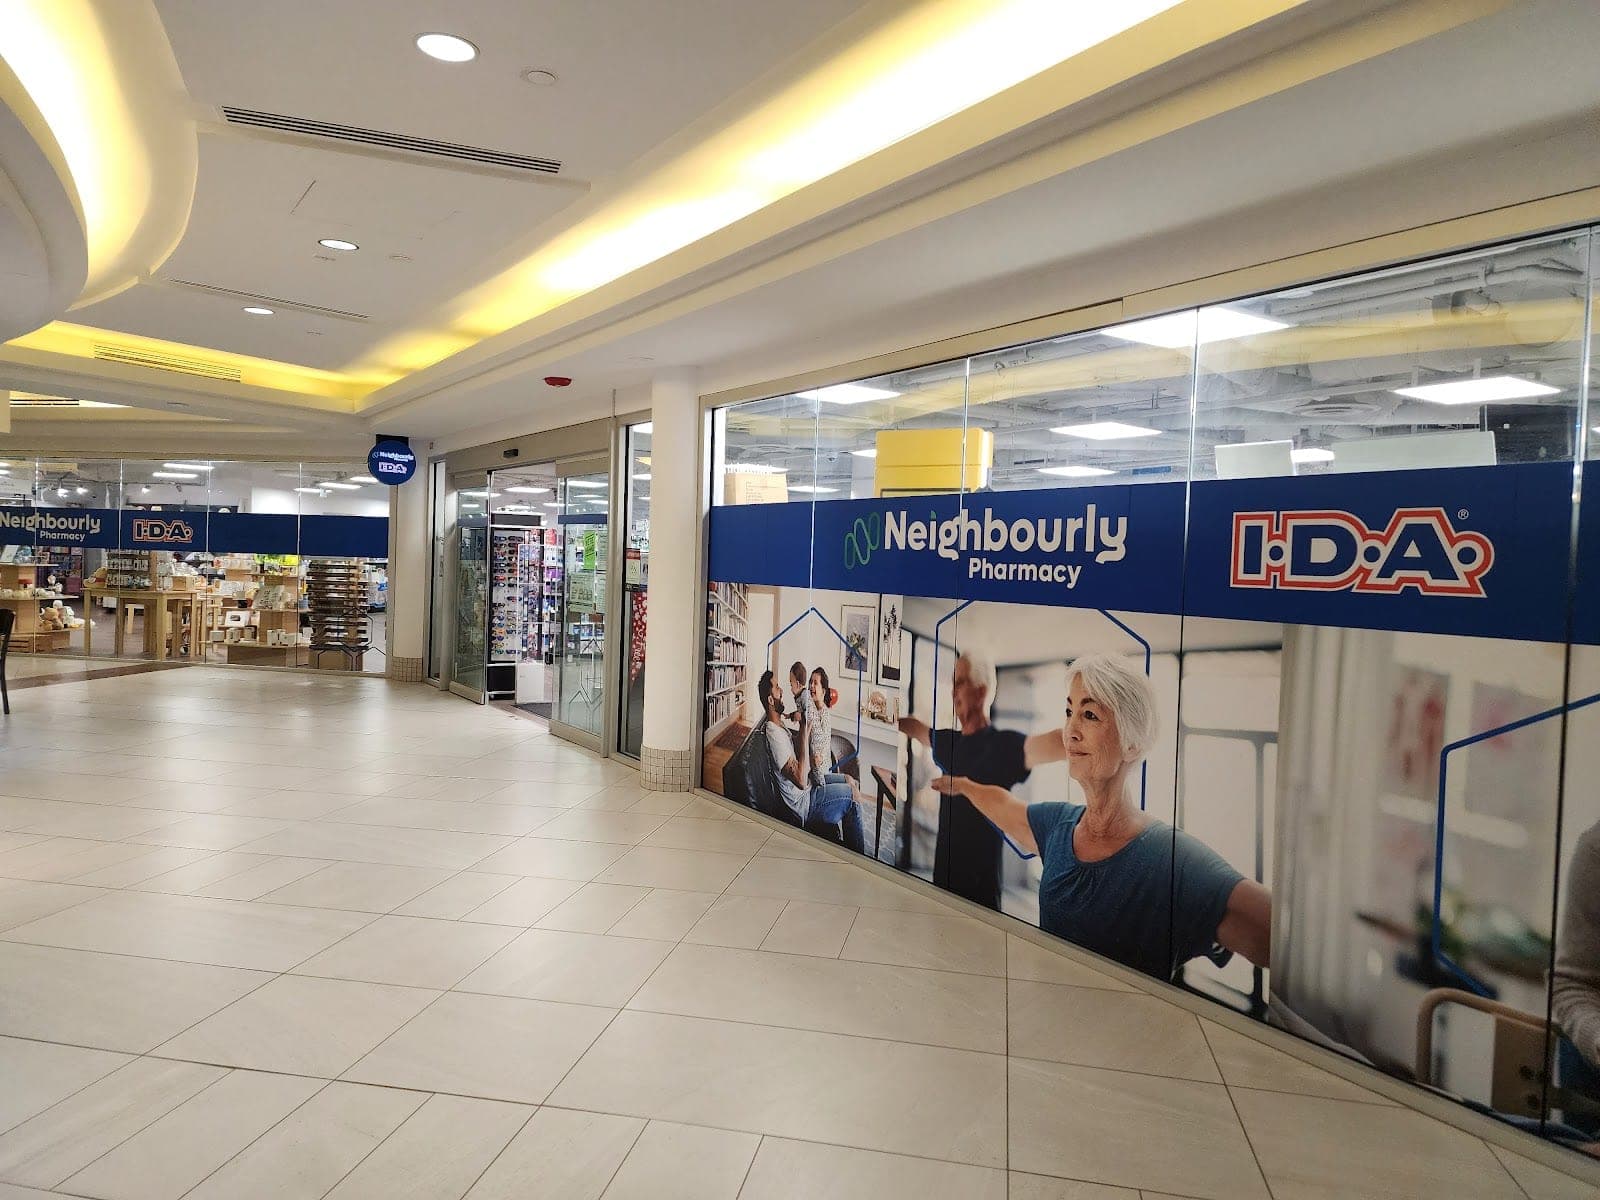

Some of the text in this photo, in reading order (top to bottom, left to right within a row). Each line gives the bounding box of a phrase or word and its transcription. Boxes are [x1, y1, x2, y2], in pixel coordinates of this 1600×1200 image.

[0, 511, 101, 534] Neighbourly
[39, 529, 86, 543] Pharmacy
[884, 503, 1129, 564] Neighbourly
[968, 556, 1083, 590] Pharmacy
